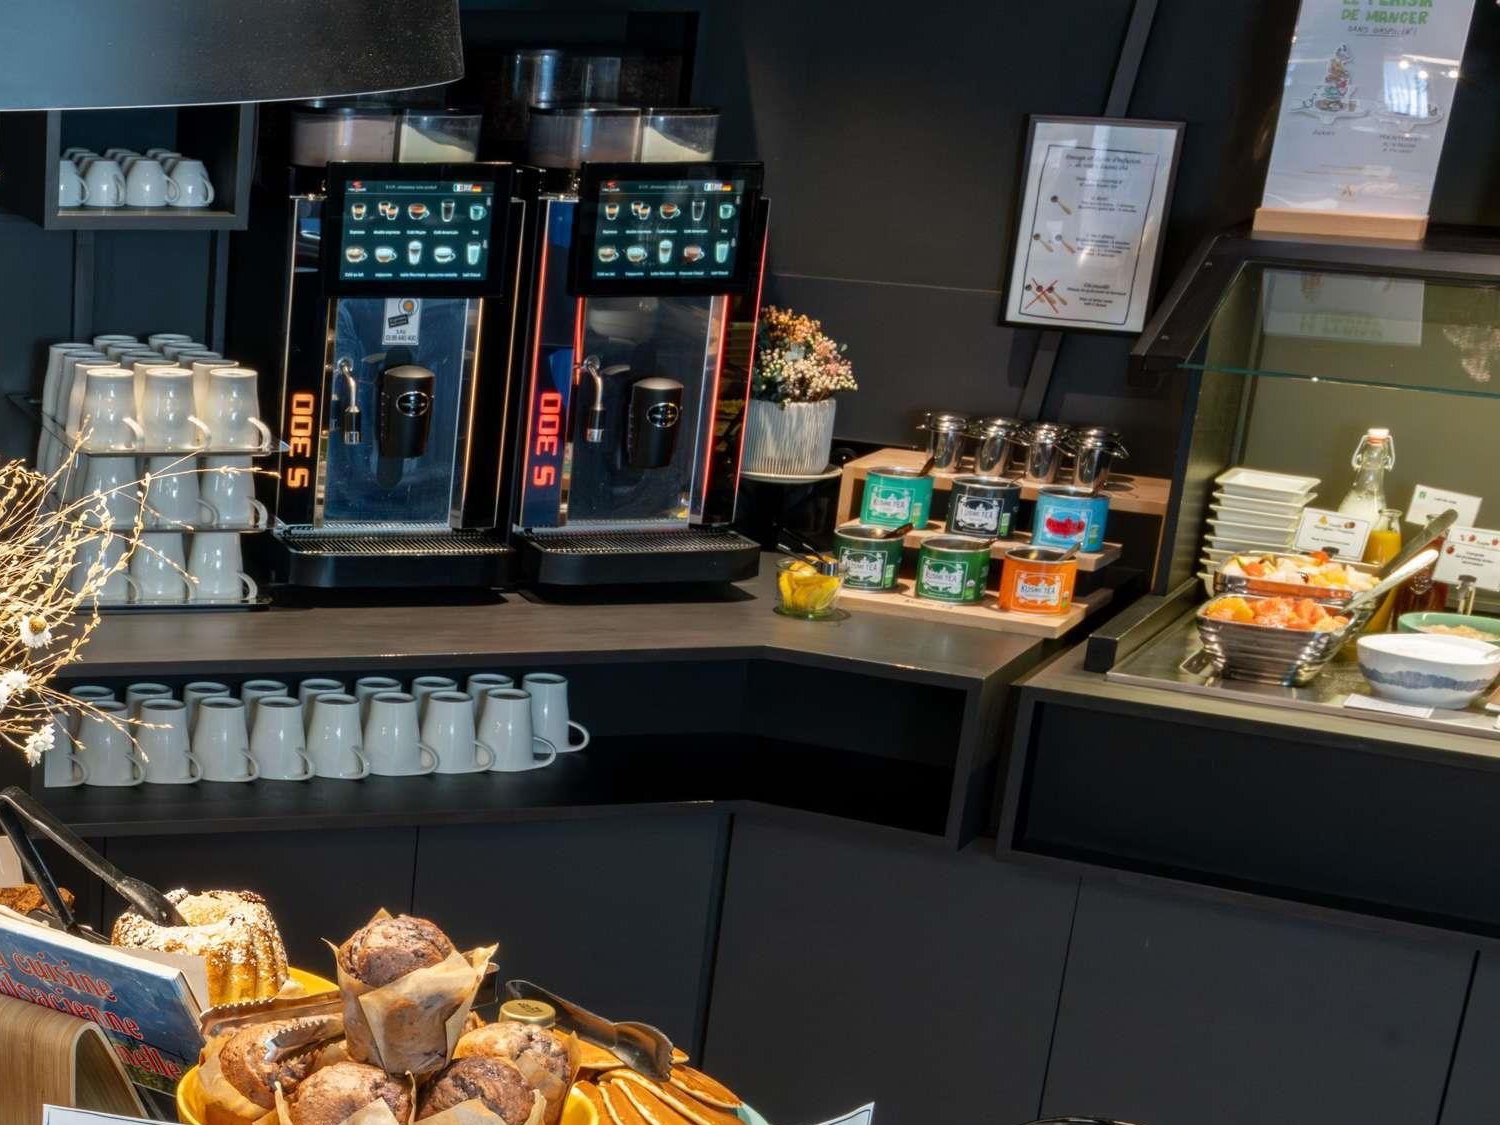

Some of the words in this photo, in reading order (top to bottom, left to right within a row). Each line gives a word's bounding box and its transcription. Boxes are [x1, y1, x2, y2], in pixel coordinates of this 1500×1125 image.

[1341, 9, 1360, 21] DE
[1365, 10, 1429, 24] MANGER
[945, 574, 957, 583] TEA
[1044, 586, 1055, 594] TEA
[12, 951, 117, 1002] cuisine
